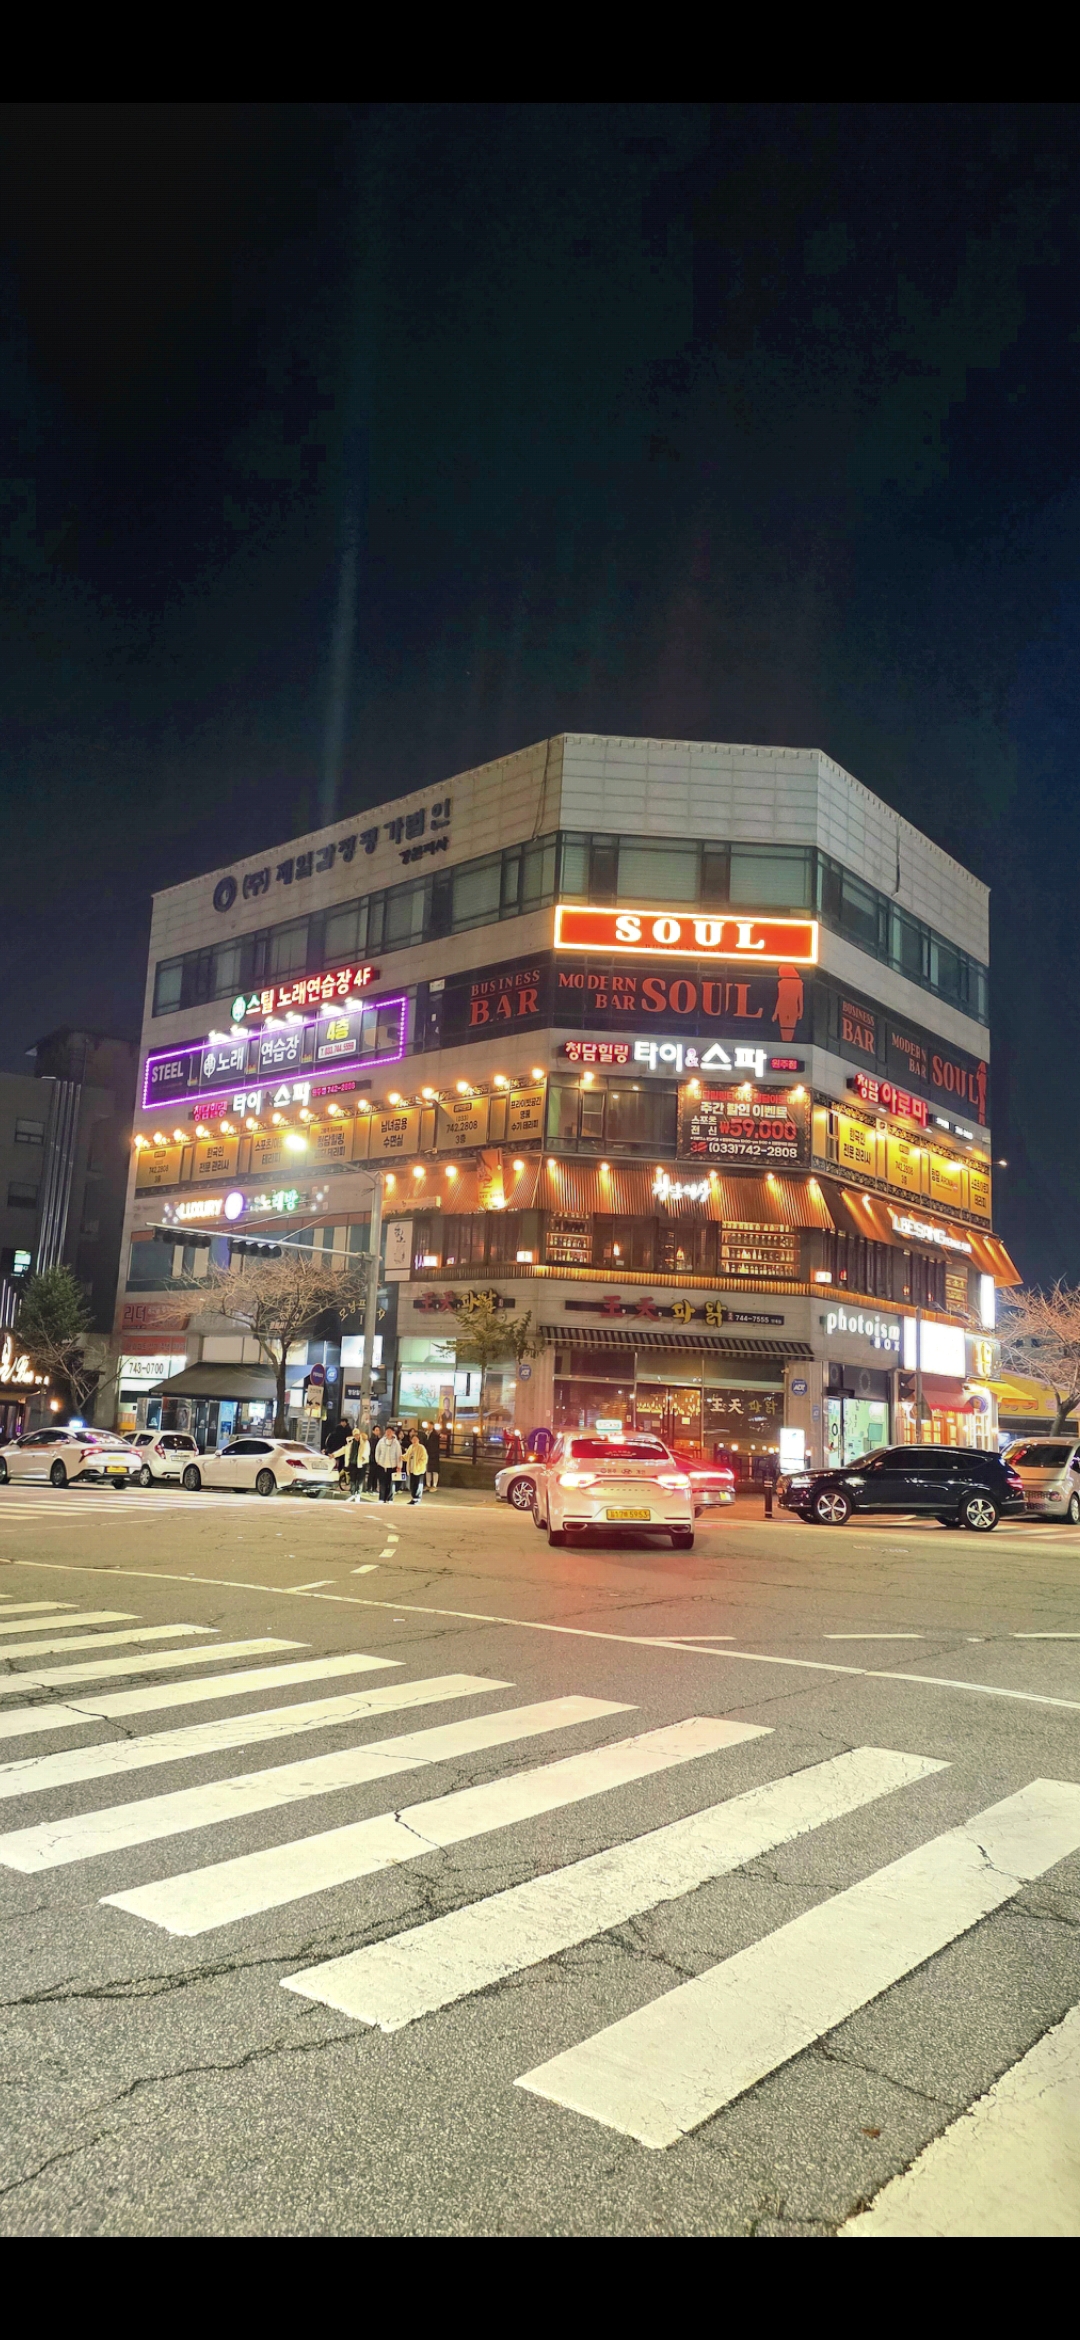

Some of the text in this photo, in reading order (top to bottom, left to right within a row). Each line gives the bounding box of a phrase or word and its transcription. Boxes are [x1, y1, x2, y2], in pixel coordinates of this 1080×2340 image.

[615, 915, 765, 949] SOUL
[246, 966, 372, 1015] 스틸 노래연습장 4F
[471, 970, 540, 997] BUSINESS
[558, 973, 764, 1018] MODERN SOUL
[469, 988, 540, 1027] BAR
[595, 993, 637, 1011] BAR
[842, 1001, 875, 1026] BUSINESS
[842, 1017, 876, 1054] BAR
[217, 1035, 300, 1072] 노래 연습장
[565, 1042, 629, 1063] 청담힐링
[771, 1058, 798, 1070] 원주점
[151, 1061, 184, 1083] STEEL
[892, 1032, 979, 1105] MODERN SOUL
[909, 1058, 927, 1079] BAR
[701, 1102, 788, 1118] 주간 할인 이벤트
[857, 1073, 928, 1127] 청담 아로마
[381, 1117, 408, 1133] 남녀공용
[446, 1120, 478, 1133] 742.2808
[383, 1134, 404, 1148] 수면실
[708, 1142, 798, 1158] (033)742-2808
[735, 1314, 769, 1324] 744-7555
[827, 1307, 900, 1341] photoism
[129, 1363, 164, 1375] 743-0700
